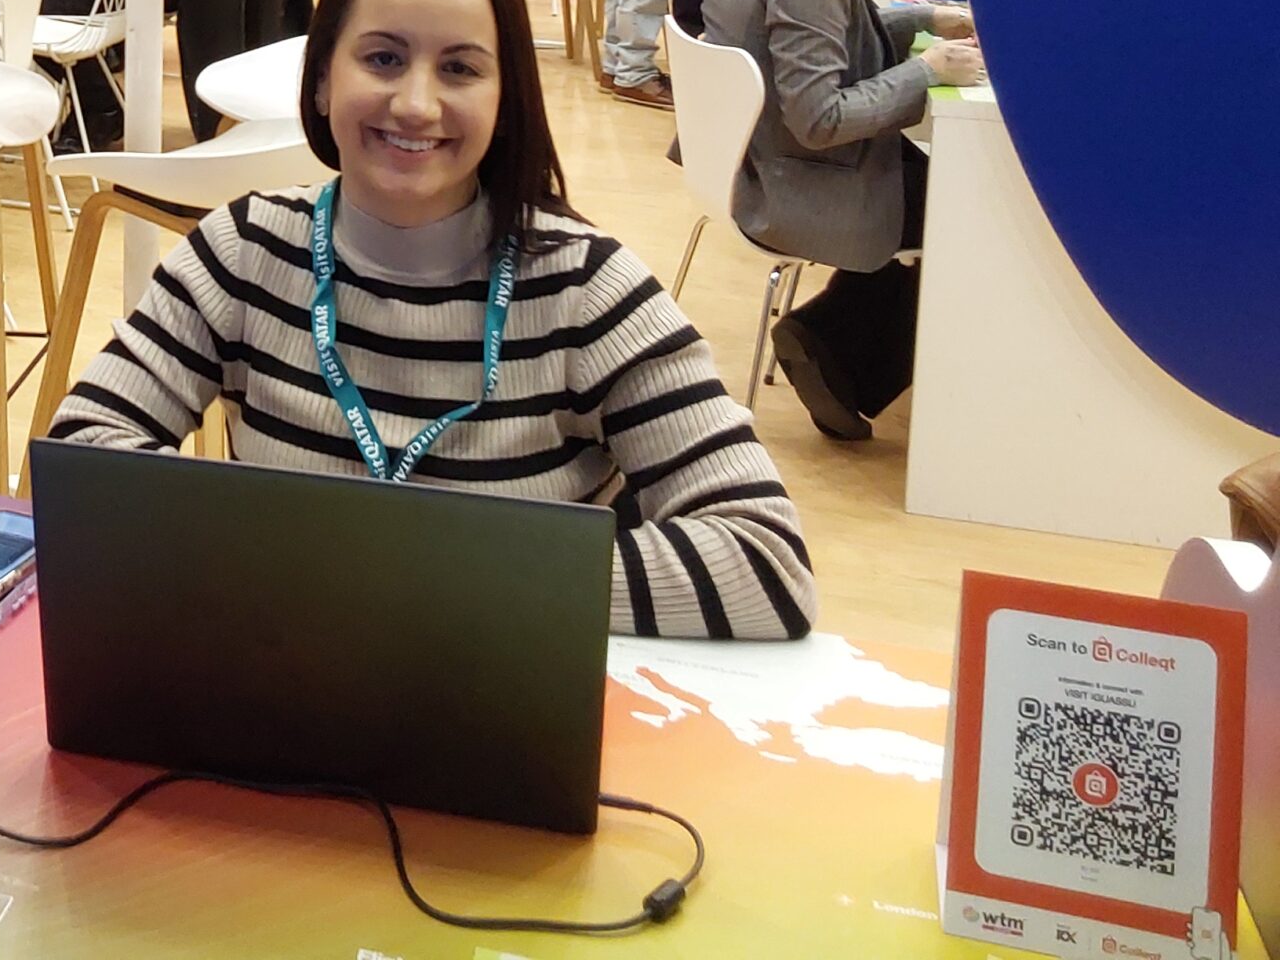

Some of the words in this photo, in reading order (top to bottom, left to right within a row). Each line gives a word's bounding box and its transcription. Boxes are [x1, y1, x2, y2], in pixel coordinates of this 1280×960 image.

[1027, 633, 1067, 652] Scan
[1072, 641, 1088, 655] to
[1116, 648, 1176, 672] Colleqt
[1065, 688, 1088, 700] VISIT
[1091, 693, 1137, 708] IGUASSU
[872, 899, 938, 920] London
[982, 911, 1024, 931] wtm
